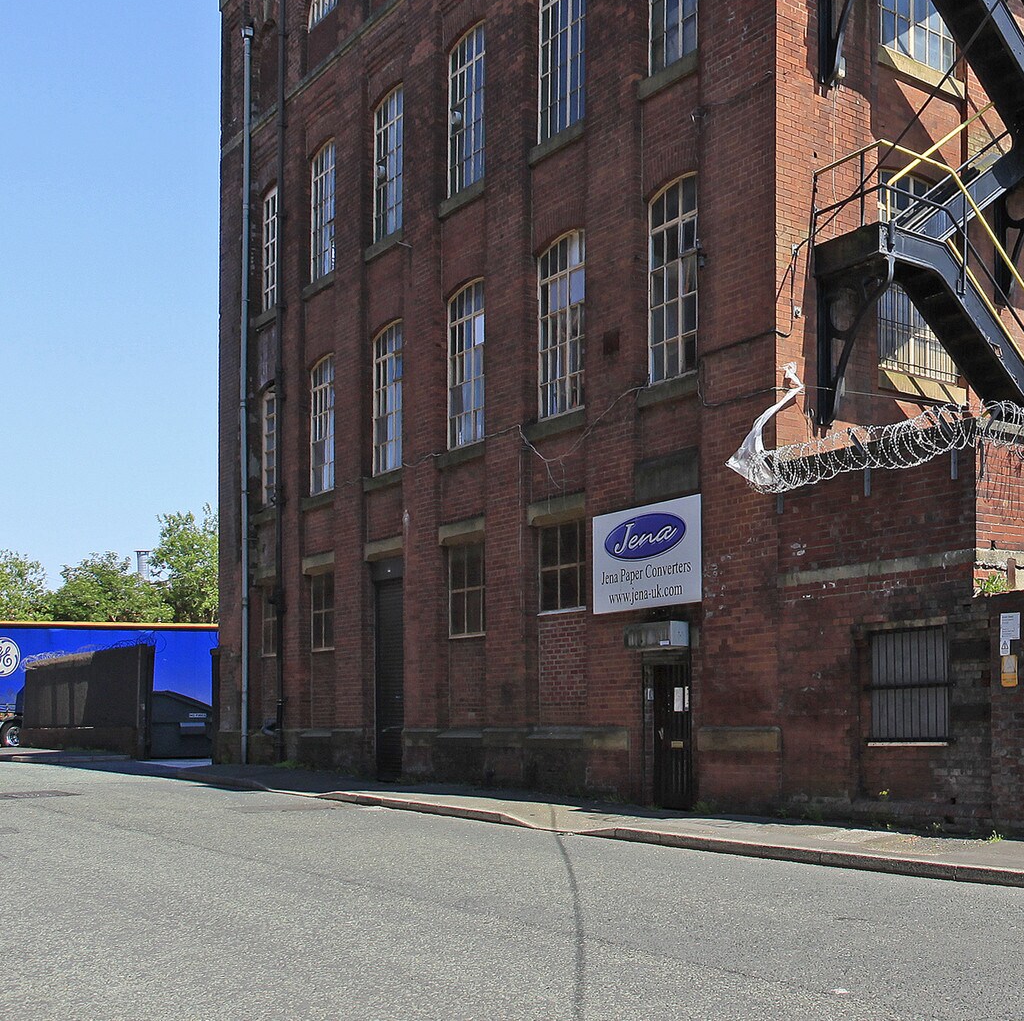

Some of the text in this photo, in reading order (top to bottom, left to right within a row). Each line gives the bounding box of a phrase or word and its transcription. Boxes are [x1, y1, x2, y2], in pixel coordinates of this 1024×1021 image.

[614, 522, 678, 554] Jena
[601, 561, 692, 586] Jena Paper Converters
[609, 584, 683, 606] www.jena-uk.com
